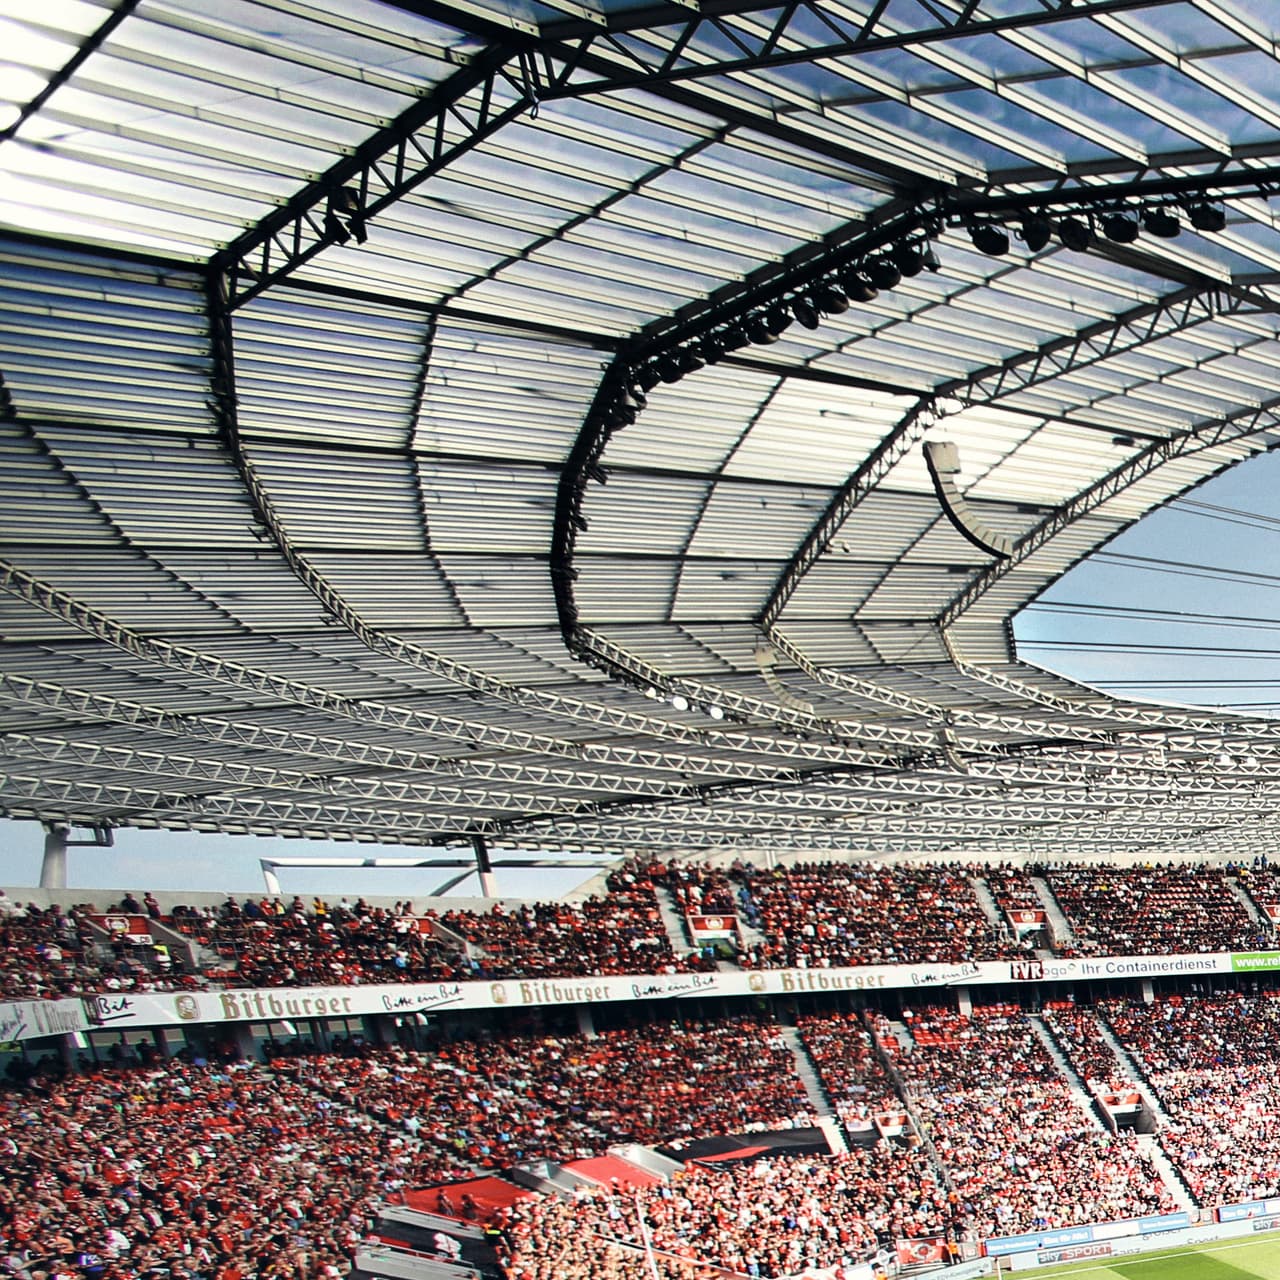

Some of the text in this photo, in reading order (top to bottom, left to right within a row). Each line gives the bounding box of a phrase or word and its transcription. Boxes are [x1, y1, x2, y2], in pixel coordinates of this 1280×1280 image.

[1081, 962, 1101, 975] Ihr
[1105, 957, 1217, 976] Containerdienst
[781, 971, 885, 993] Bitburger
[519, 981, 611, 1005] Bitburger
[99, 996, 134, 1015] Bit
[219, 991, 351, 1020] Bitburger
[1065, 1243, 1110, 1258] SPORT
